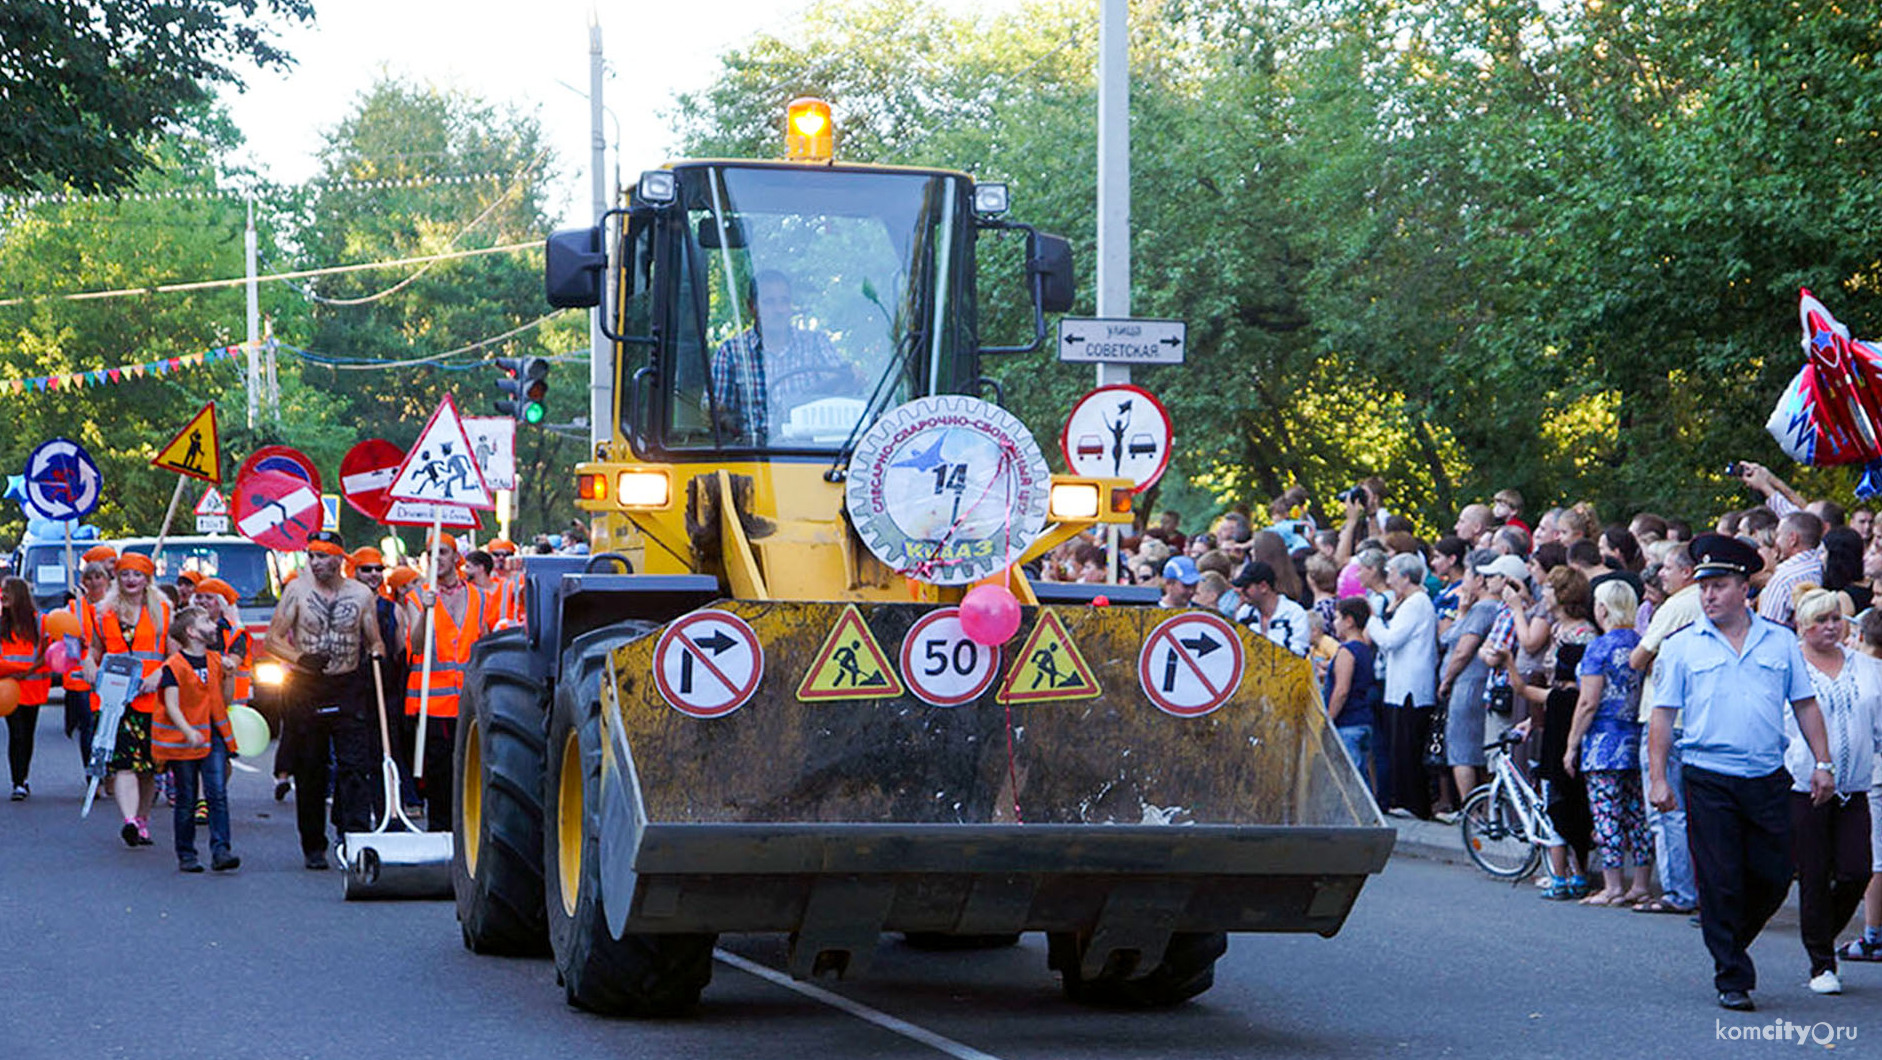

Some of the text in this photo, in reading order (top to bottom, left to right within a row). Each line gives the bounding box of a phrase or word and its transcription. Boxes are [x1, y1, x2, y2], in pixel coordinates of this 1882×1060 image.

[1085, 343, 1160, 358] СОВЕТСКАЯ
[932, 463, 968, 495] 14
[924, 638, 978, 676] 50
